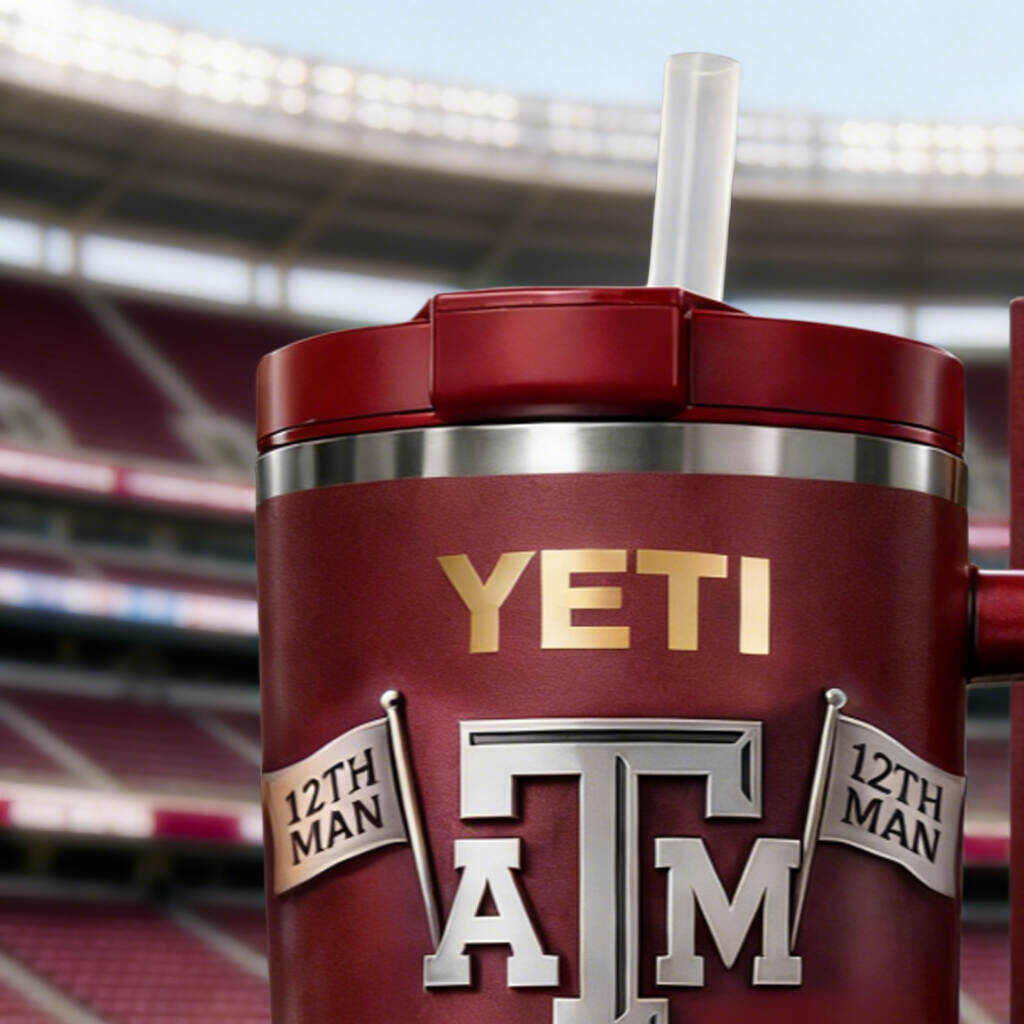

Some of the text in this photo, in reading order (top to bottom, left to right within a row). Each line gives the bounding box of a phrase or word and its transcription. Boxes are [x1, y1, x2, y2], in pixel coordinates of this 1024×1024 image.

[437, 549, 770, 654] YETI
[286, 748, 378, 827] 12TH
[850, 743, 944, 816] 12TH
[290, 796, 384, 866] MAN
[841, 797, 941, 865] MAN
